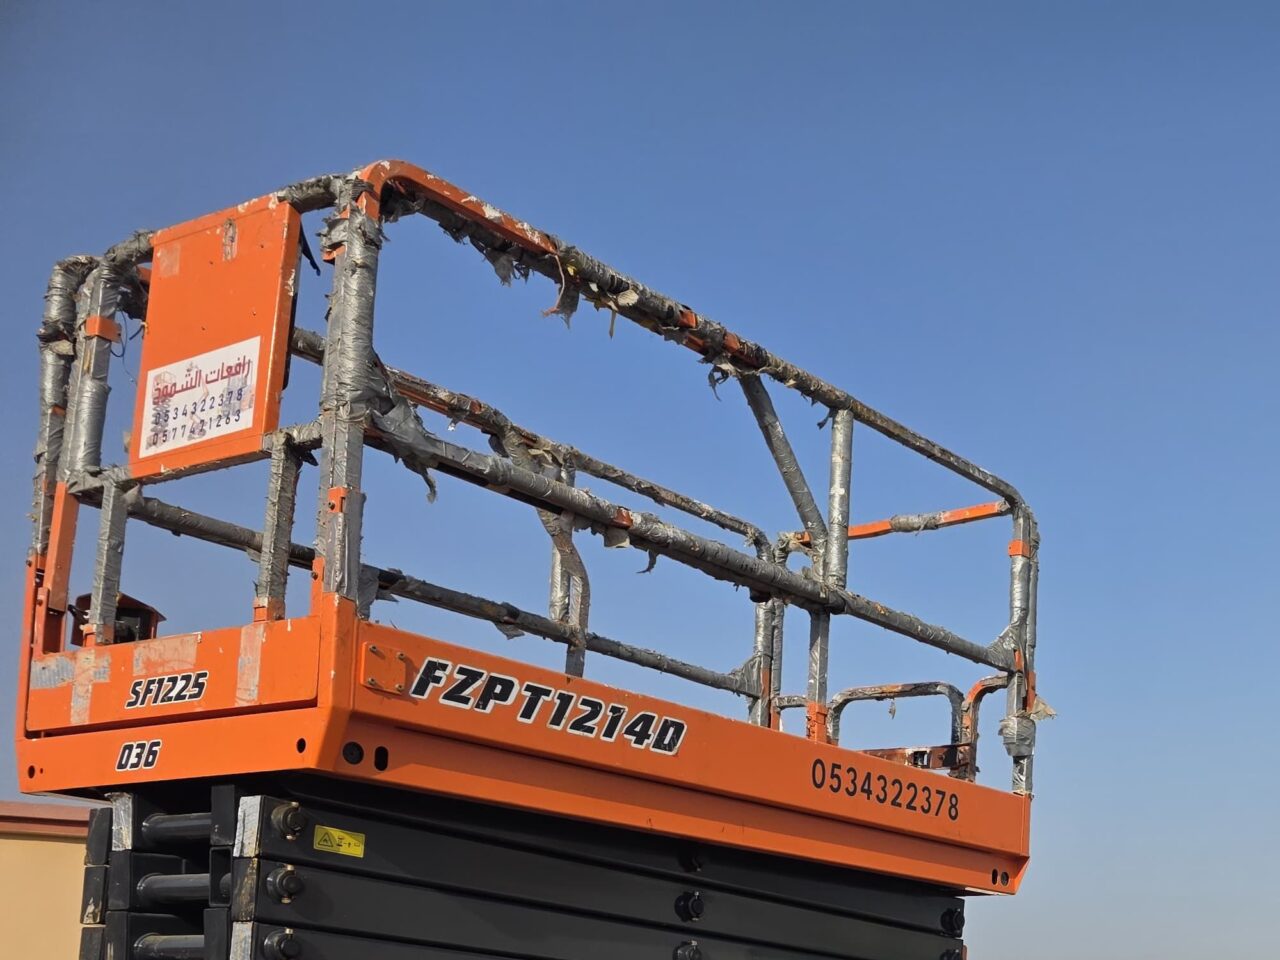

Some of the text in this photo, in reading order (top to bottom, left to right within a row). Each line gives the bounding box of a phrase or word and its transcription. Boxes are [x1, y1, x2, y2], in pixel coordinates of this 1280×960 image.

[205, 355, 251, 385] رافعات
[154, 388, 243, 425] 0534322378
[152, 409, 241, 445] 0577471263
[126, 671, 209, 708] SF1225
[116, 740, 161, 770] 036
[811, 758, 959, 821] 0534322378
